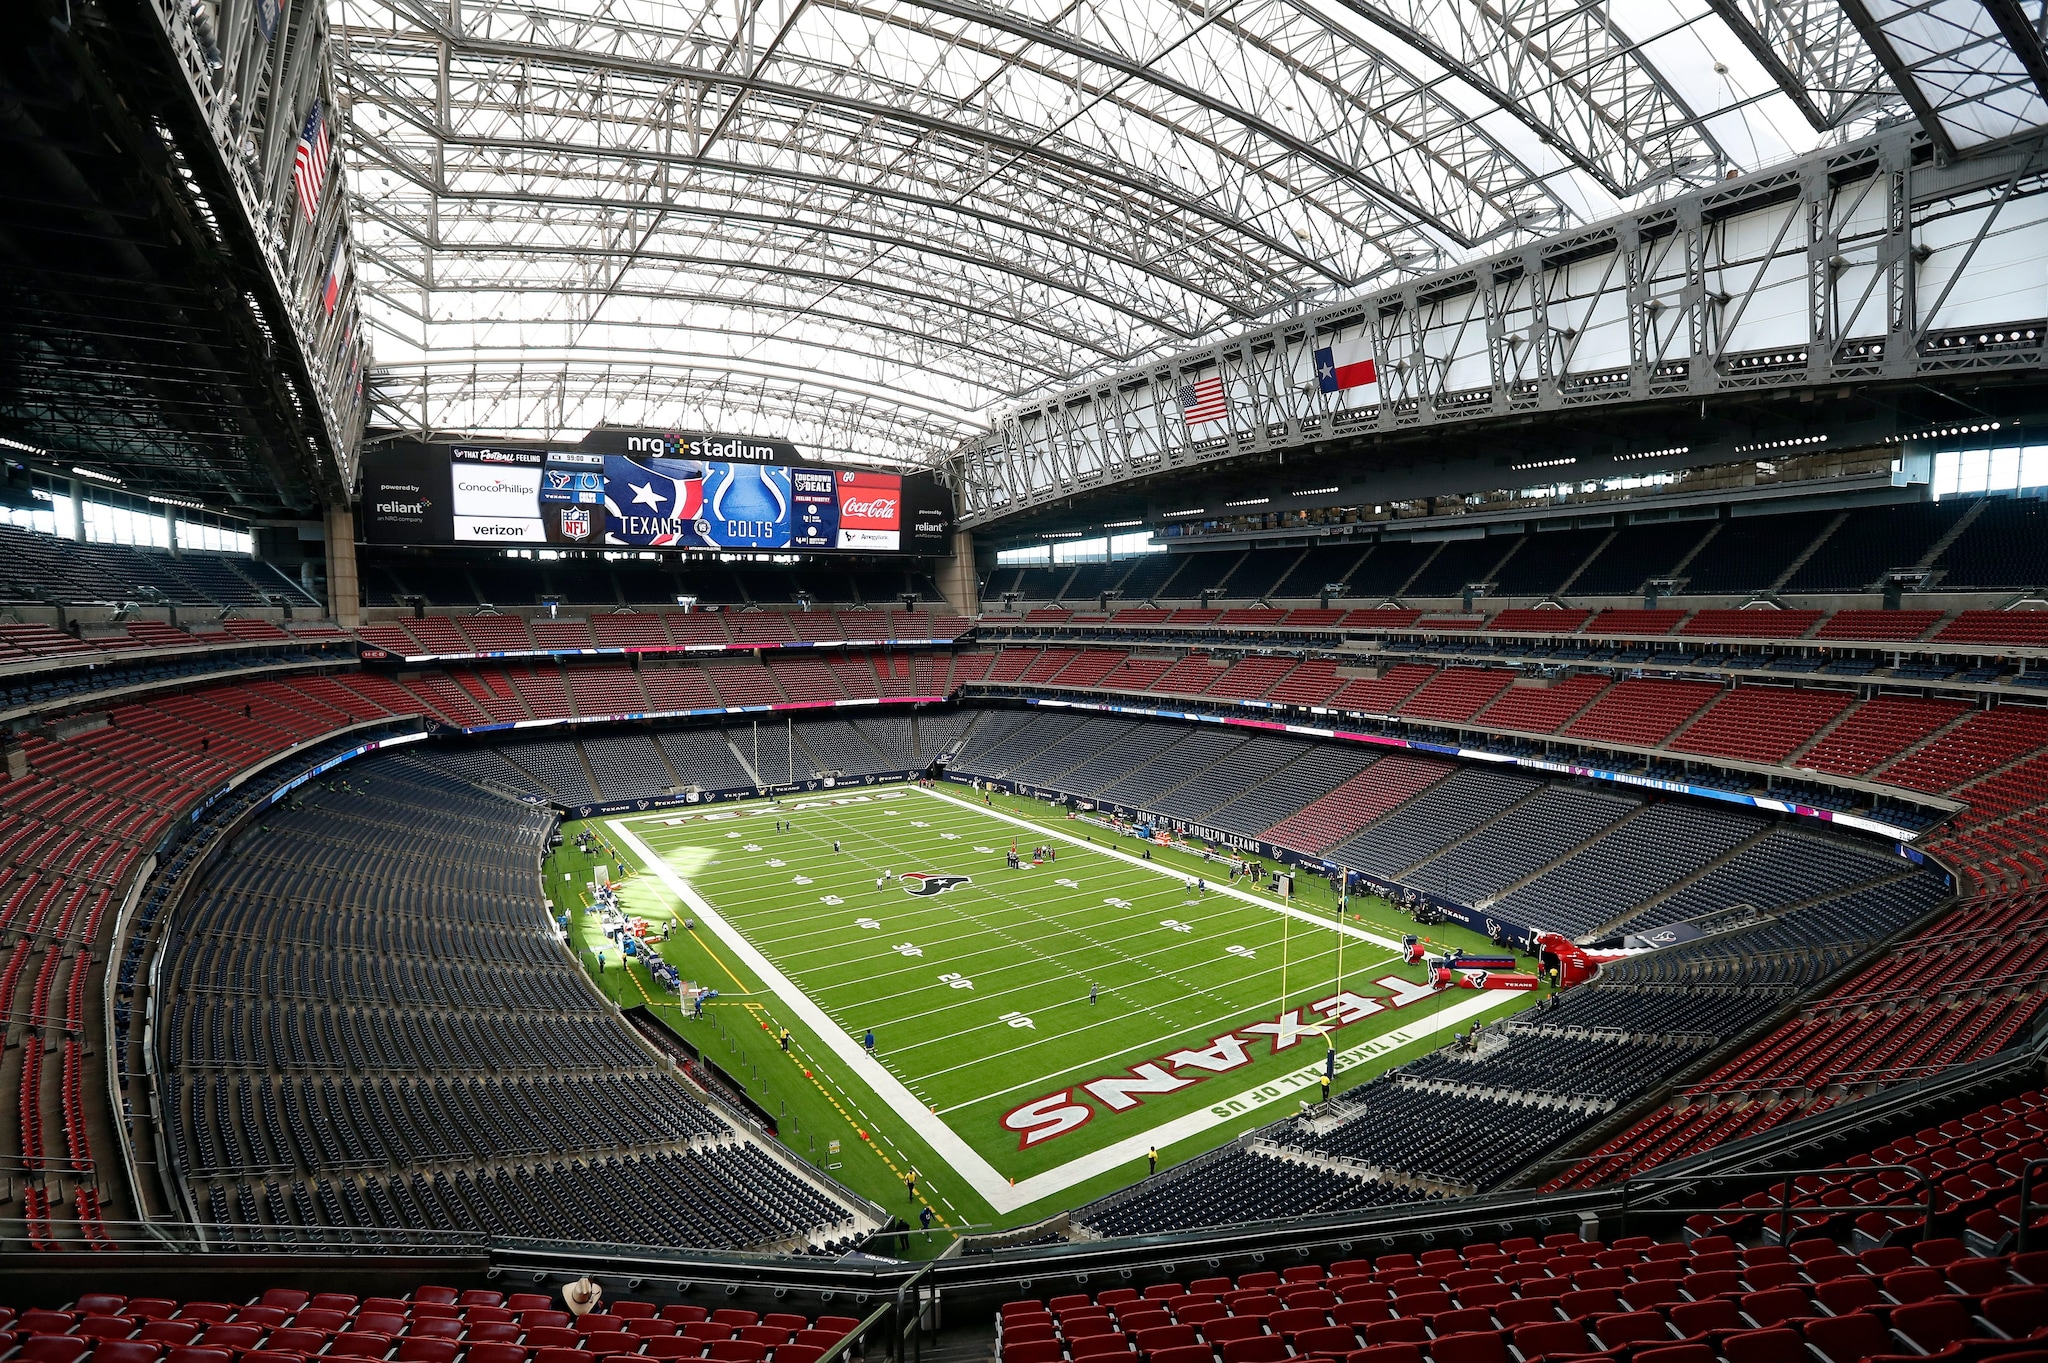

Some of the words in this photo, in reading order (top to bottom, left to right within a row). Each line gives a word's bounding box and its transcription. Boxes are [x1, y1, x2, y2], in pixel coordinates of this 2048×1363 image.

[628, 436, 664, 457] nrg
[690, 437, 774, 460] stadium
[464, 451, 479, 459] THAT
[516, 454, 541, 463] FEELING
[794, 473, 832, 482] TOUCHDOWN
[843, 472, 855, 482] GO
[458, 482, 534, 495] ConocoPhillips
[805, 482, 832, 492] DEALS
[376, 501, 423, 514] reliant
[473, 525, 523, 536] verizon
[565, 521, 586, 535] NFL
[621, 516, 682, 535] TEXANS
[728, 520, 773, 538] COLTS
[915, 522, 943, 532] reliant
[1517, 758, 1543, 768] HOUSTON
[1546, 762, 1570, 773] TEXANS
[1614, 773, 1663, 789] INDIANAPOLIS
[1665, 782, 1689, 794] COLTS
[1172, 819, 1187, 832] THE
[1189, 822, 1226, 844] HOUSTON
[1229, 835, 1260, 854] TEXANS
[1299, 860, 1326, 872] TEXANS
[1436, 905, 1470, 923] TEXANS
[855, 918, 880, 929] 40
[1159, 919, 1194, 932] 20
[892, 942, 923, 956] 30
[1225, 945, 1257, 958] 10
[937, 972, 973, 989] 20
[998, 1011, 1031, 1028] 10
[1389, 1031, 1413, 1044] IT
[1000, 975, 1457, 1151] TEXANS
[1333, 1042, 1390, 1070] TAKES
[1280, 1067, 1324, 1088] ALL
[1251, 1086, 1281, 1103] OF
[1211, 1100, 1248, 1118] US
[865, 1254, 898, 1265] Chevron
